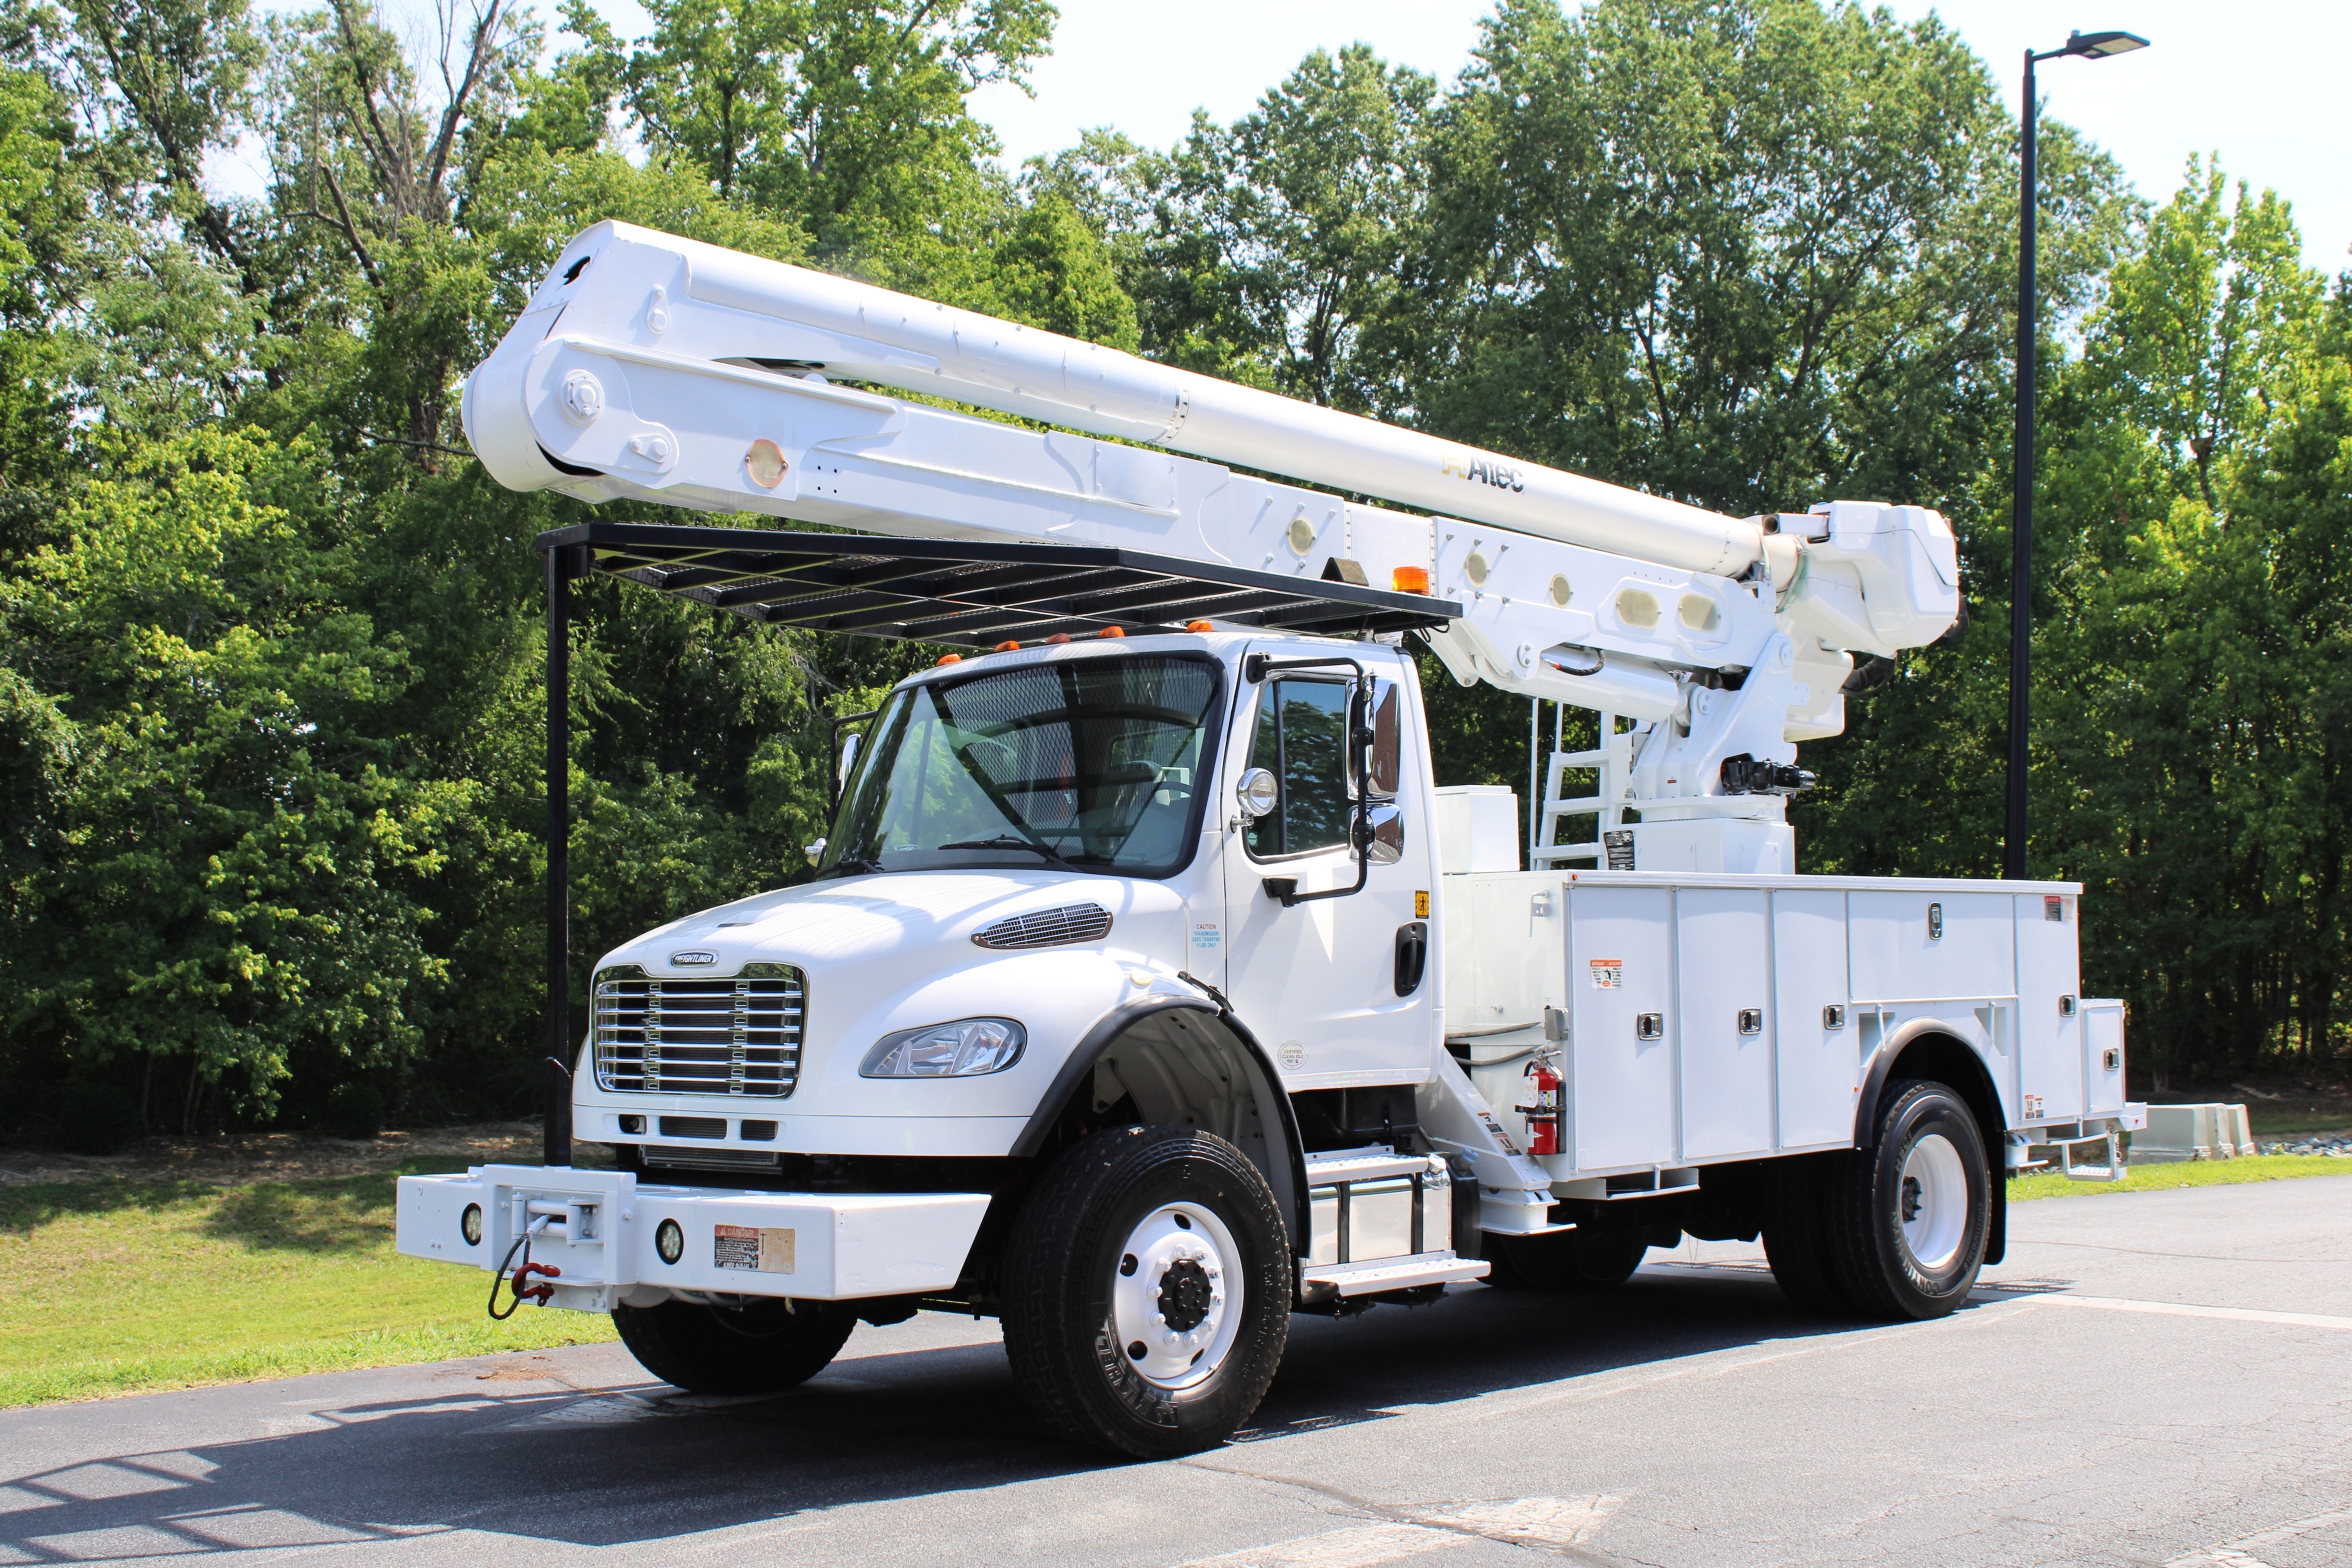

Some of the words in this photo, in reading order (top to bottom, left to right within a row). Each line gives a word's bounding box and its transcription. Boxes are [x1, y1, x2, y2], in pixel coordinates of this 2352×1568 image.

[674, 954, 712, 963] FREIGHTLINER
[727, 1228, 753, 1237] DANGER
[1094, 1314, 1152, 1416] MICHELI
